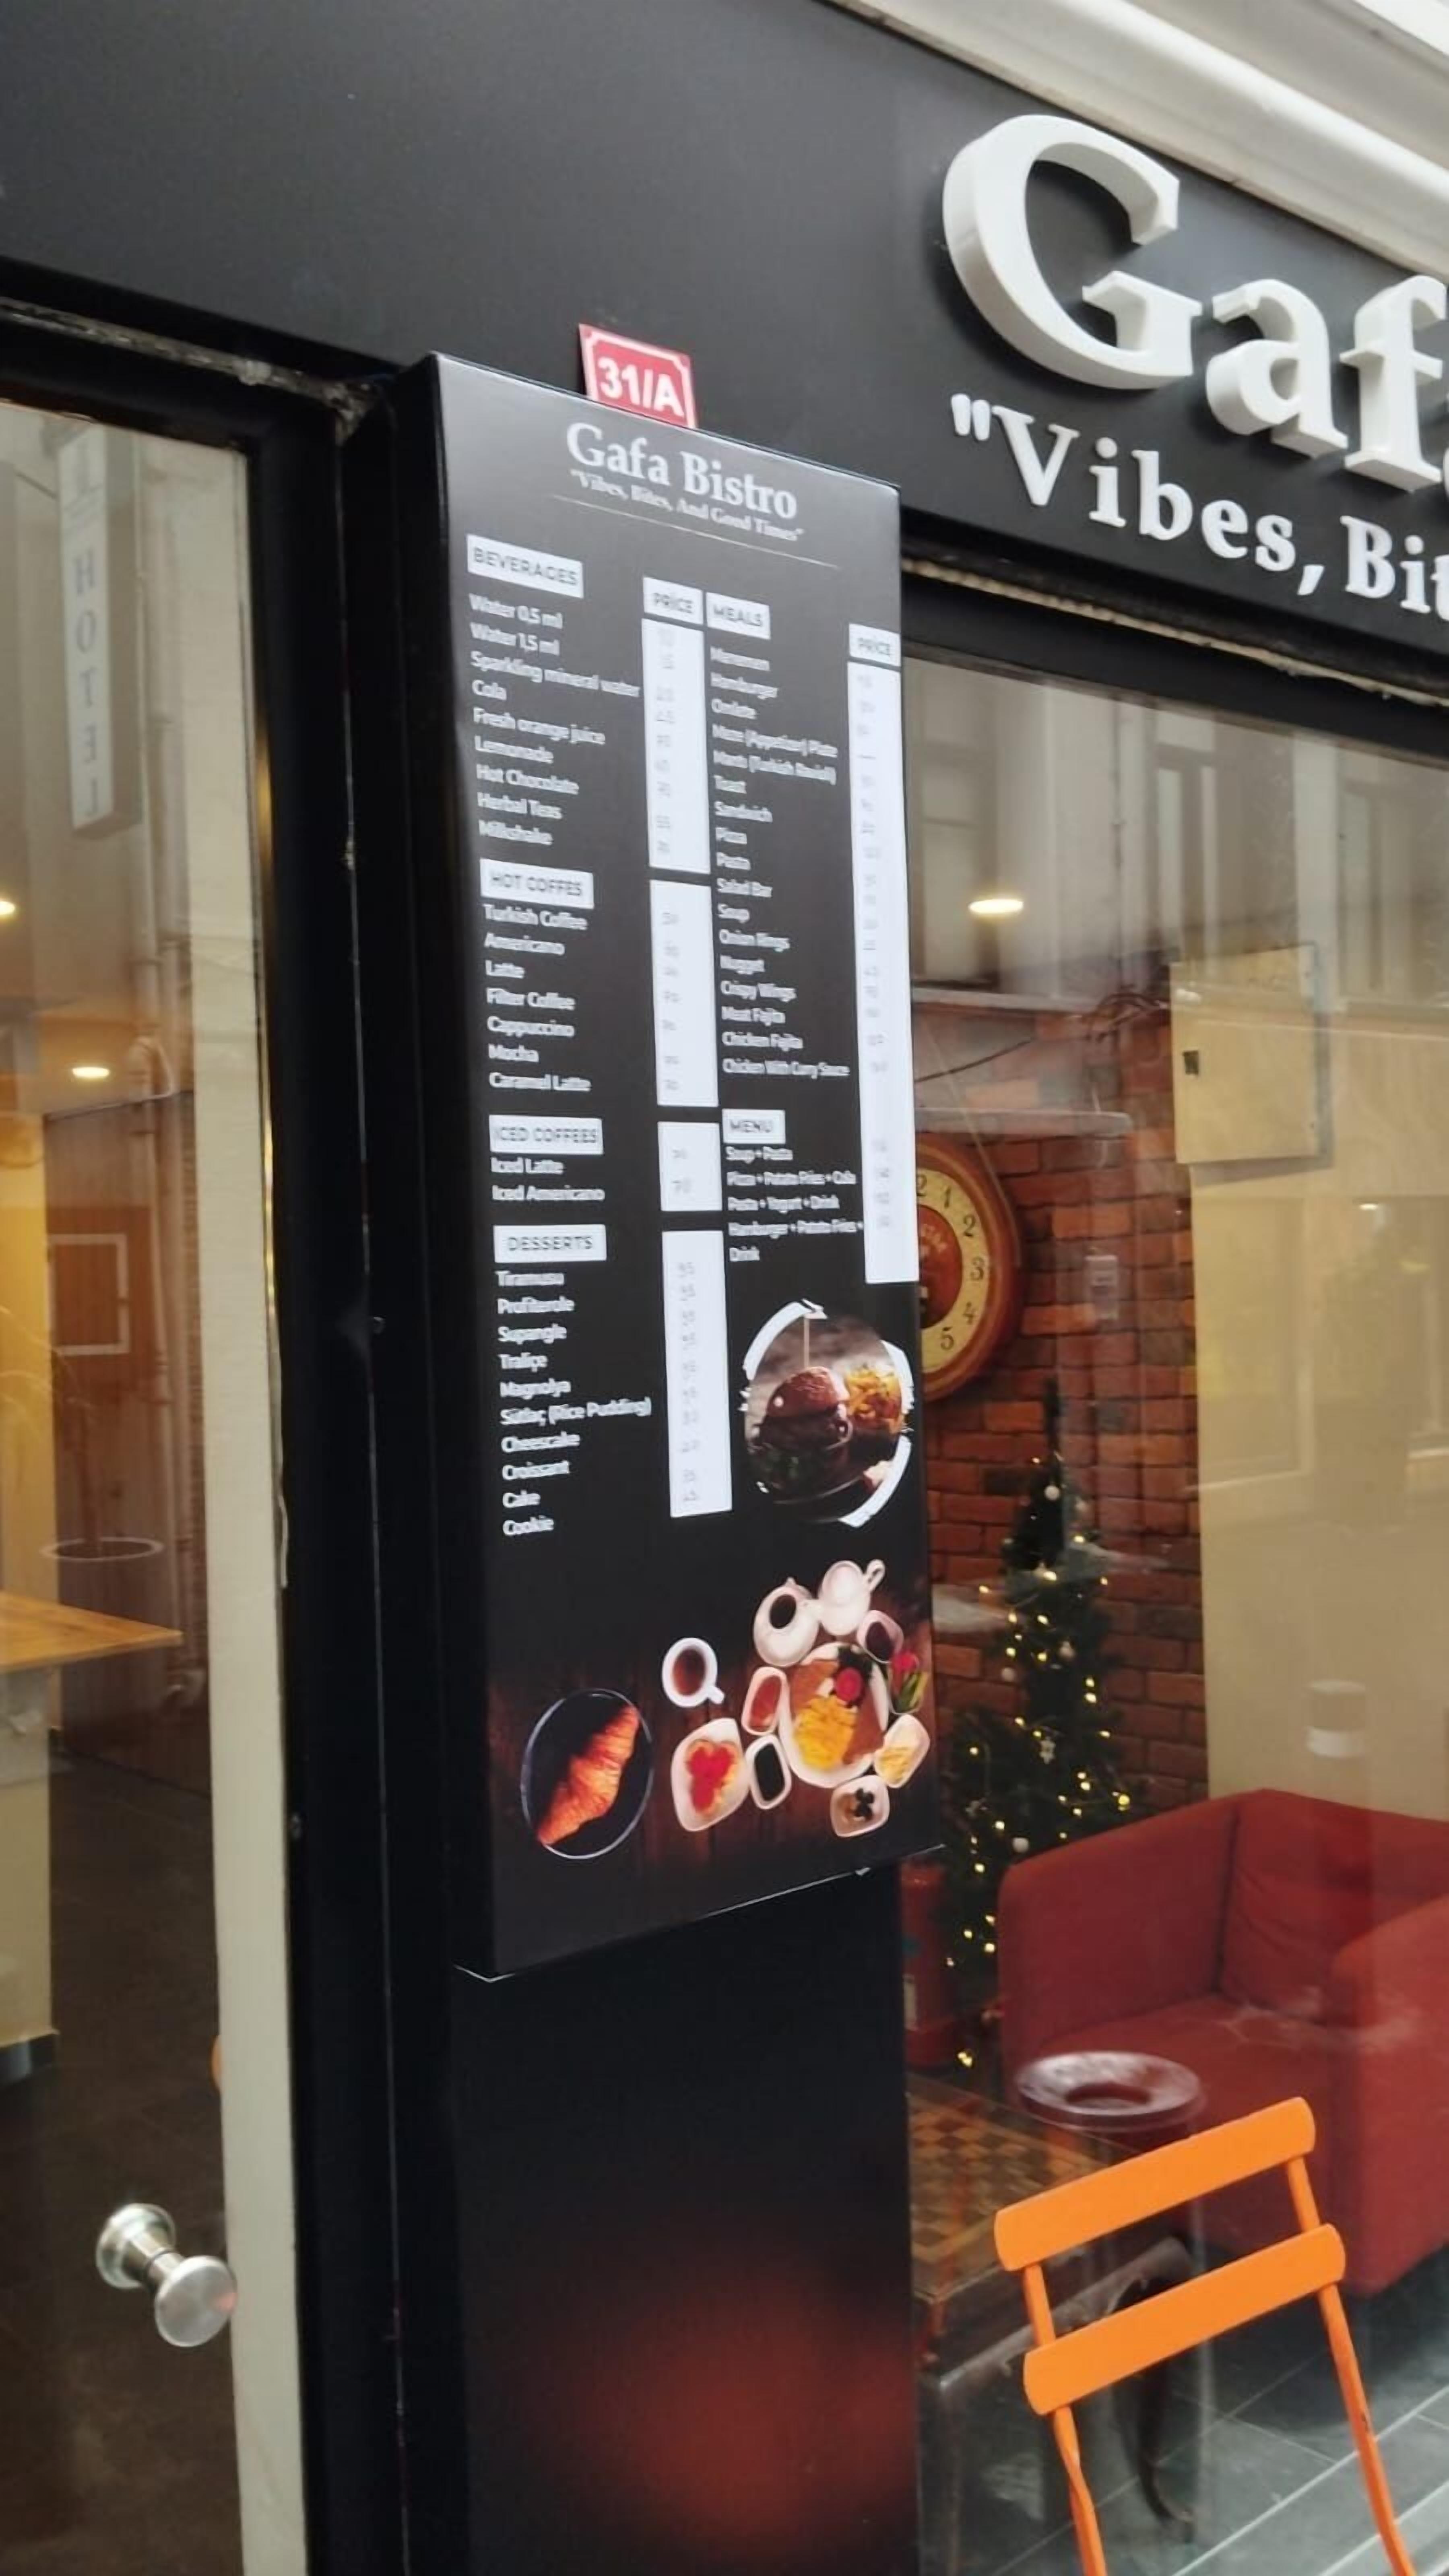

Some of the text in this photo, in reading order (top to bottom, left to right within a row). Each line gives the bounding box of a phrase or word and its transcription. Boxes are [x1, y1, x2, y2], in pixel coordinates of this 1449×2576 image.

[942, 114, 1449, 492] Gaf
[598, 357, 685, 417] 31/A
[567, 422, 797, 519] Gafa Bistro
[951, 393, 1325, 596] "Vibes,
[676, 499, 708, 520] And
[711, 508, 751, 530] Good
[474, 547, 577, 586] BEVERAGES
[469, 593, 515, 618] Water
[542, 613, 563, 629] ml
[713, 605, 763, 627] MEALS
[470, 622, 516, 646] Water
[539, 639, 560, 656] ml
[471, 650, 640, 697] Sparkling mineral water
[472, 680, 506, 700] Cola
[473, 707, 606, 744] Fresh orange juice
[475, 735, 553, 764] Lemonade
[476, 764, 579, 795] Hot Chocolate
[477, 792, 527, 814] Herbal
[479, 819, 553, 845] Milkshake
[491, 871, 520, 888] HOT
[483, 904, 588, 930] Turkish Coffee
[717, 903, 750, 924] Soup
[484, 932, 565, 956] Americano
[485, 960, 525, 979] Latte
[486, 987, 576, 1010] Filter Coffee
[722, 1031, 770, 1048] Chicken
[488, 1043, 539, 1062] Mocha
[489, 1072, 591, 1091] Caramel Latte
[495, 1127, 597, 1143] ICED COFFEES
[730, 1119, 774, 1133] MENU
[491, 1156, 564, 1174] Iced Latte
[492, 1185, 605, 1201] Iced Americano
[964, 1214, 976, 1236] 2
[508, 1235, 593, 1251] DESSERTS
[970, 1257, 985, 1281] 3
[966, 1302, 974, 1324] 4
[940, 1327, 954, 1351] 5
[502, 1490, 541, 1508] Cake
[502, 1515, 554, 1536] Cookie
